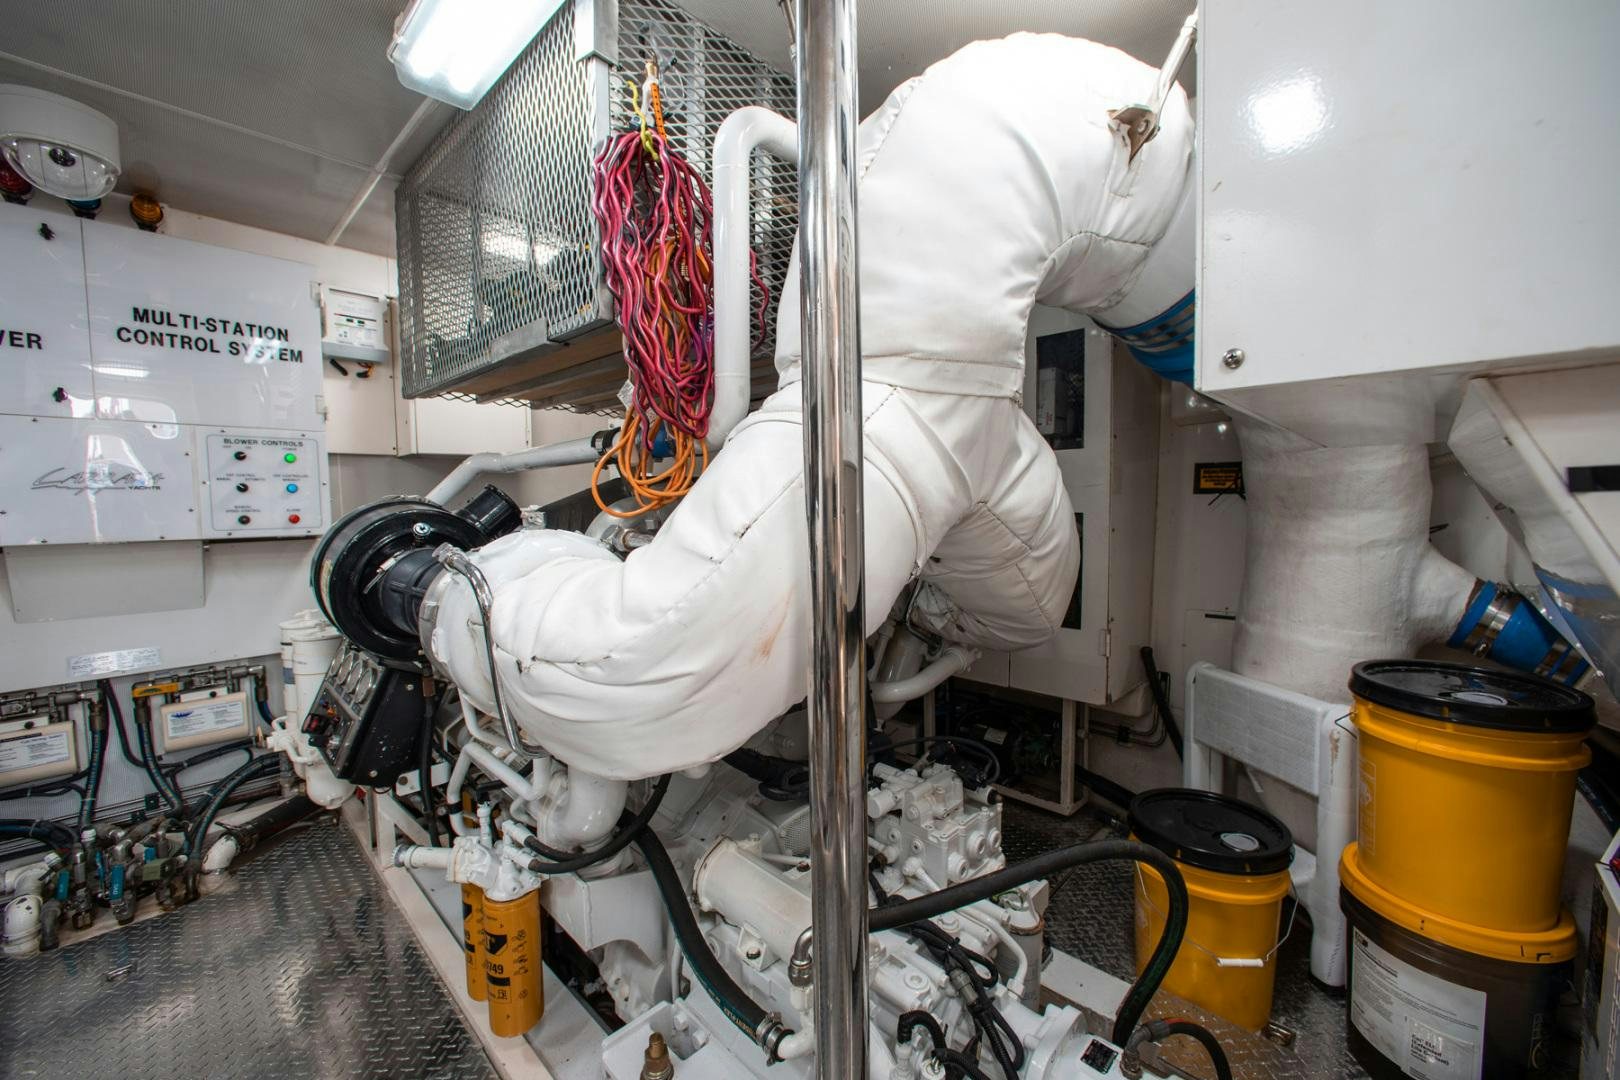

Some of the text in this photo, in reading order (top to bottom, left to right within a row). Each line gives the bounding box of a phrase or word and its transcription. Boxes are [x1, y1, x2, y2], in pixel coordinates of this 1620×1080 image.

[132, 306, 289, 342] MULTI-STATION
[116, 326, 221, 354] CONTROL
[261, 439, 304, 447] CONTROLS
